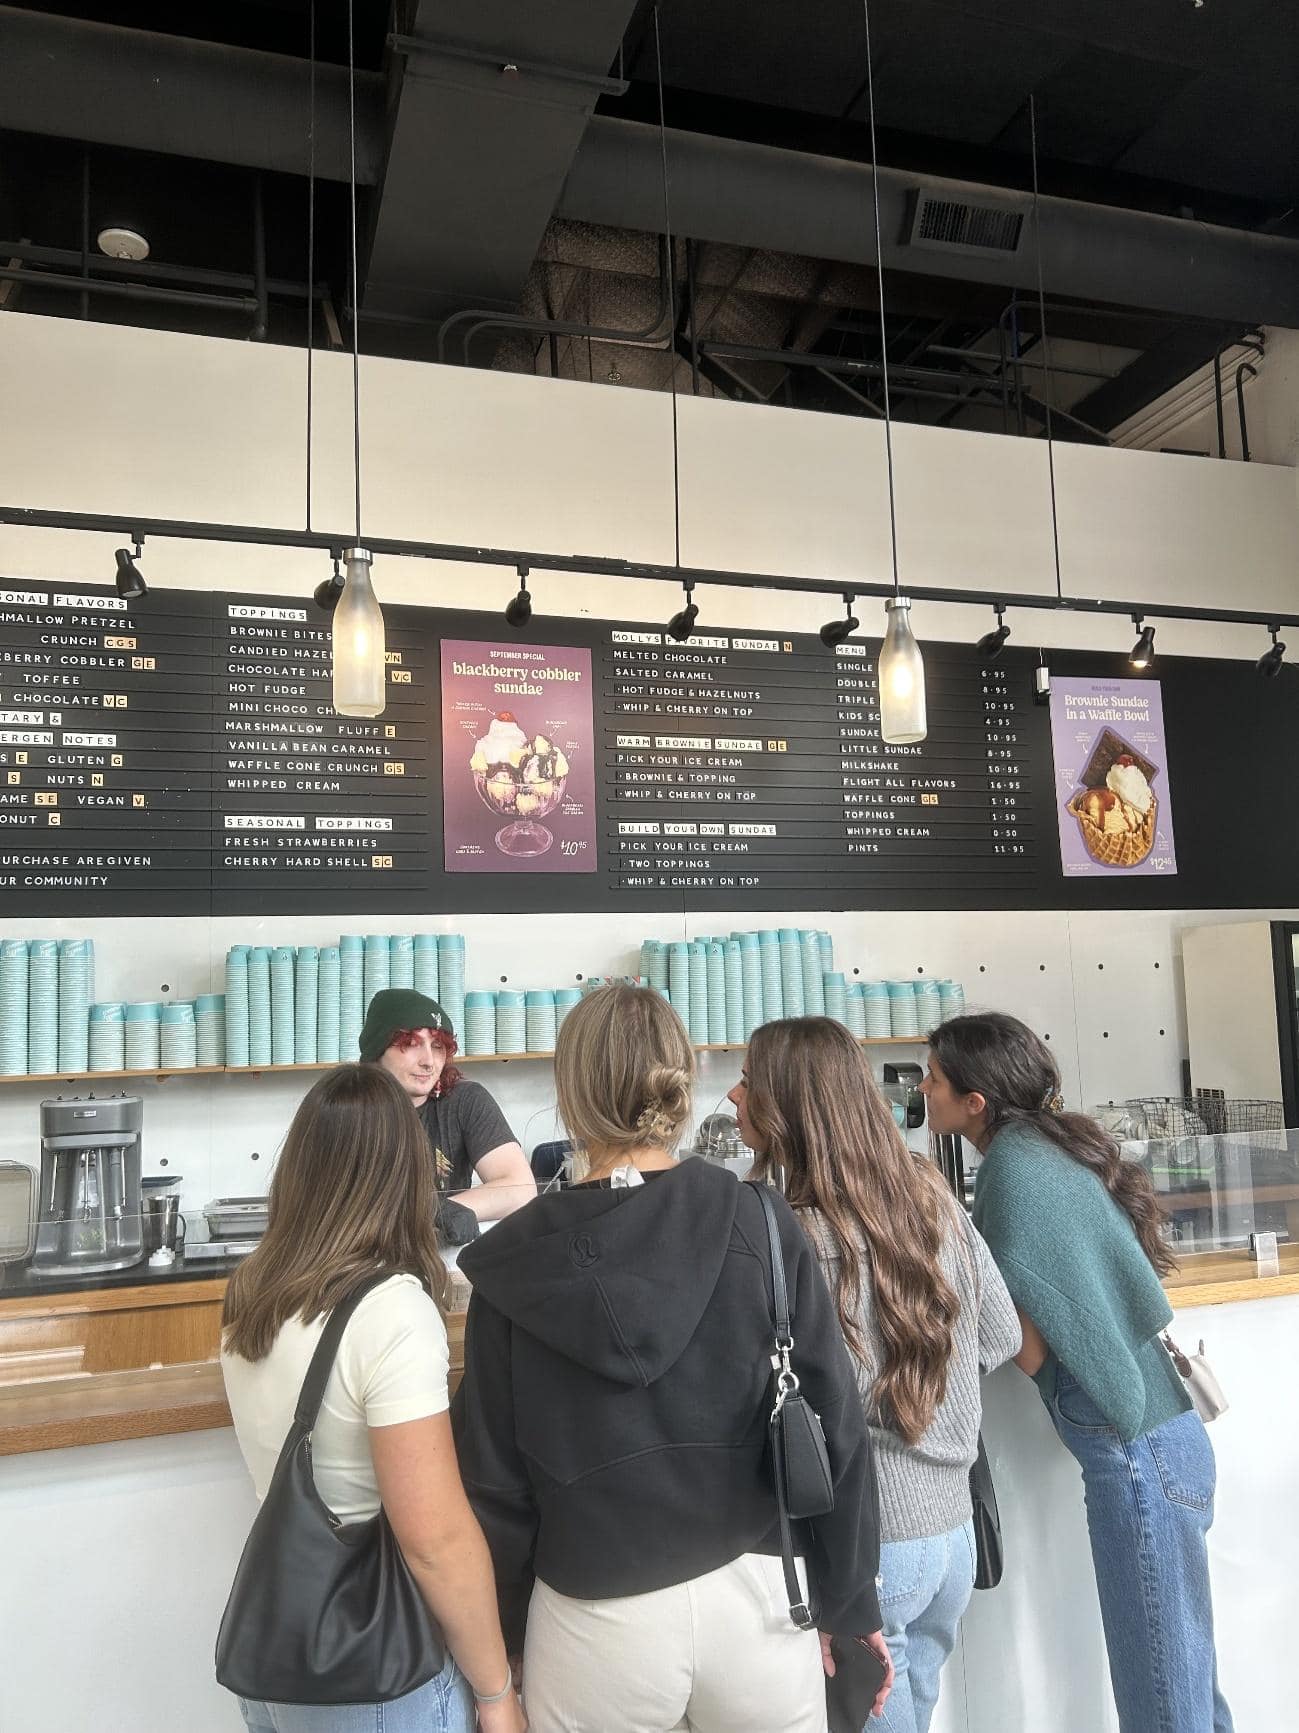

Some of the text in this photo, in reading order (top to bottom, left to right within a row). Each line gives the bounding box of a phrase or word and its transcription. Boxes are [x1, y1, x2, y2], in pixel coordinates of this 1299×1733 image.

[0, 593, 125, 609] ONAL FLAVORS
[230, 607, 305, 620] TOPPINGS
[71, 616, 136, 629] PRETZEL
[230, 626, 333, 641] BROWNIE BITES
[40, 635, 98, 646] CRUNCH
[612, 632, 778, 650] MOLLYS FVORITE SUNDAE
[229, 645, 288, 657] CANDIED
[294, 649, 334, 660] HAZEL
[489, 650, 546, 661] SEPTEMBER SPECIAL
[836, 647, 865, 655] MENU
[0, 652, 52, 664] BERRY
[60, 655, 126, 667] COBBLER
[613, 650, 728, 665] MELTED CHOCOLATE
[228, 664, 306, 676] CHOCOLATE
[452, 661, 582, 682] blackberry cobbler
[836, 662, 873, 672] SINGLE
[23, 673, 81, 685] TOFFEE
[615, 667, 714, 681] SALTED CARAMEL
[229, 683, 306, 695] HOT FUDGE
[494, 681, 544, 696] sundae
[837, 679, 877, 688] DOUBLE
[649, 686, 685, 697] FUDGE
[688, 688, 695, 697] &
[698, 689, 761, 700] HAZELNUTS
[13, 693, 99, 705] CHOCOLATE
[837, 695, 875, 705] TRIPLE
[1064, 694, 1149, 708] Brownie Sundae
[229, 702, 308, 714] MINI CHOCO
[654, 703, 662, 712] &
[666, 704, 709, 714] CHERRY
[713, 706, 728, 715] ON
[733, 707, 753, 716] TOP
[838, 712, 863, 720] KIDS
[867, 713, 881, 721] SC
[1066, 708, 1150, 722] in a Waffle Bowl
[225, 721, 324, 733] MARSHMALLOW
[338, 726, 380, 736] FLUFF
[840, 728, 880, 737] SUNDAE
[64, 736, 114, 745] NOTES
[617, 737, 650, 746] WARM
[656, 739, 710, 748] BROWNIE
[717, 741, 761, 750] SUNDAE
[228, 741, 391, 755] VANILLA BEAN CARAMEL
[840, 744, 922, 755] LITTLE SUNDAE
[47, 755, 105, 765] GLUTEN
[618, 754, 743, 767] PICK YOUR ICE CREAM
[841, 761, 899, 770] MILKSHAKE
[228, 760, 281, 770] WAFFLE
[286, 761, 321, 771] CONE
[327, 762, 378, 773] CRUNCH
[47, 775, 85, 785] NUTS
[677, 773, 684, 782] &
[689, 774, 736, 784] TOPPING
[843, 777, 881, 787] FLIGHT
[885, 778, 905, 787] ALL
[911, 779, 957, 789] FLAVORS
[227, 779, 340, 791] WHIPPED CREAM
[77, 795, 125, 805] VEGAN
[656, 790, 663, 799] &
[668, 791, 711, 800] CHERRY
[716, 791, 731, 800] ON
[736, 792, 757, 801] TOP
[844, 794, 884, 803] WAFFLE
[890, 795, 916, 803] CONE
[844, 810, 895, 820] TOPPINGS
[227, 818, 391, 829] SEASONAL TOPPINGS
[620, 825, 775, 834] BUILD YOUR OWN SUNDAE
[846, 827, 892, 836] WHIPPED
[896, 828, 930, 837] CREAM
[224, 837, 377, 848] FRESH STRAWBERRIES
[619, 842, 749, 852] PICK YOUR ICE CREAM
[848, 844, 879, 853] PINTS
[2, 855, 70, 865] URCHASE
[224, 856, 277, 866] CHERRY
[286, 857, 321, 866] HARD
[327, 857, 368, 867] SHELL
[655, 860, 710, 869] TOPPINGS
[24, 876, 108, 886] COMMUNITY
[659, 877, 666, 885] &
[671, 877, 714, 886] CHERRY
[719, 877, 734, 886] ON
[739, 877, 760, 886] TOP
